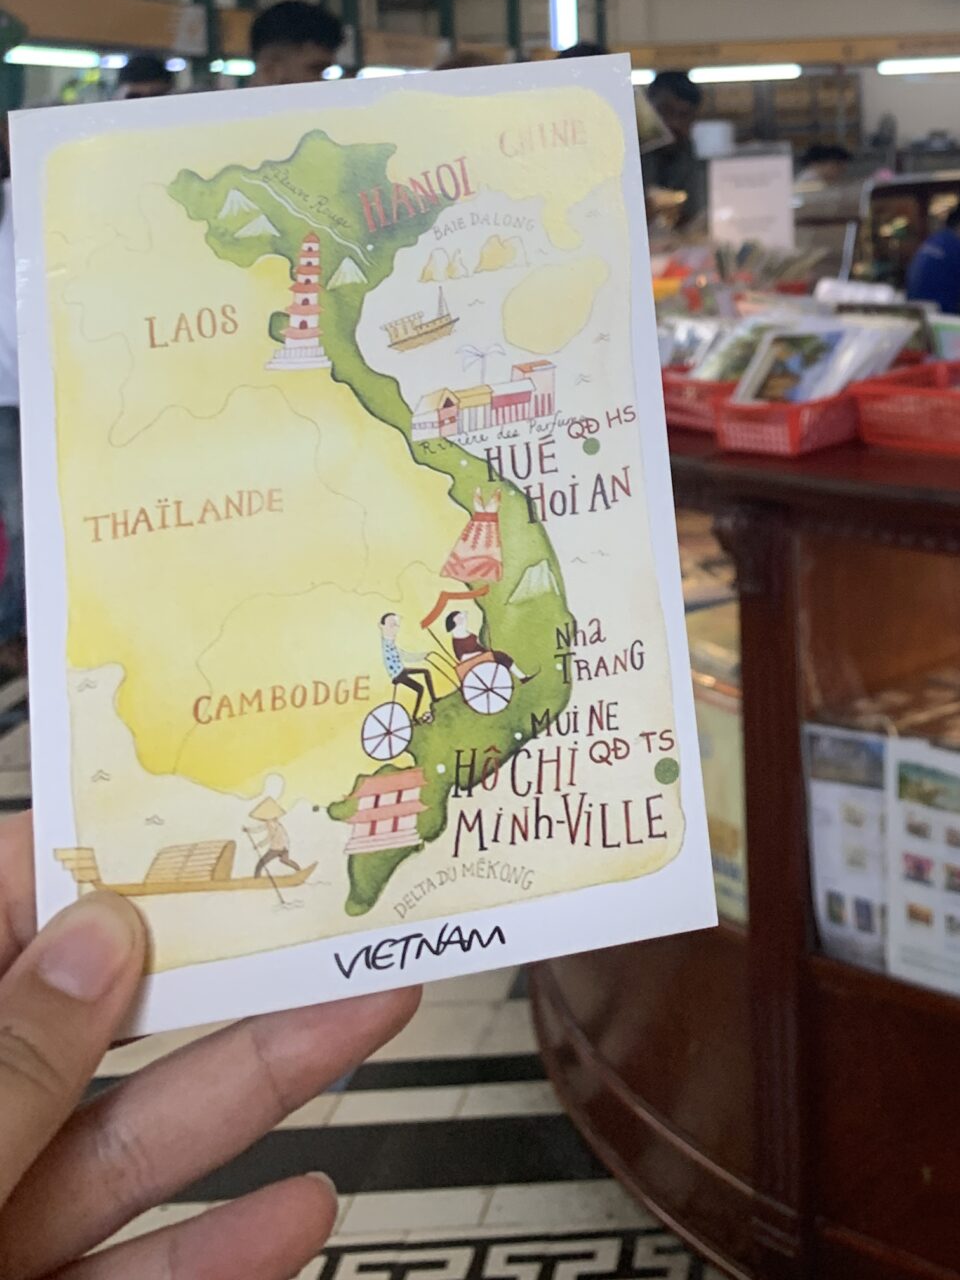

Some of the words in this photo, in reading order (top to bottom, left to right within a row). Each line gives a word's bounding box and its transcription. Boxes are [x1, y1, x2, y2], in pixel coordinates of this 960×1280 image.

[358, 156, 476, 233] HANOI
[432, 217, 466, 240] BAIE
[145, 304, 239, 348] LAOS
[605, 405, 637, 429] HS
[484, 435, 559, 482] HUÉ
[83, 489, 284, 543] THAÏLANDE
[554, 639, 645, 685] TRANG
[193, 675, 371, 725] CAMBODGE
[586, 699, 620, 737] NE
[639, 729, 675, 753] TS
[393, 877, 437, 919] DELTA
[435, 866, 458, 887] DU
[333, 922, 507, 980] VIETNAM
